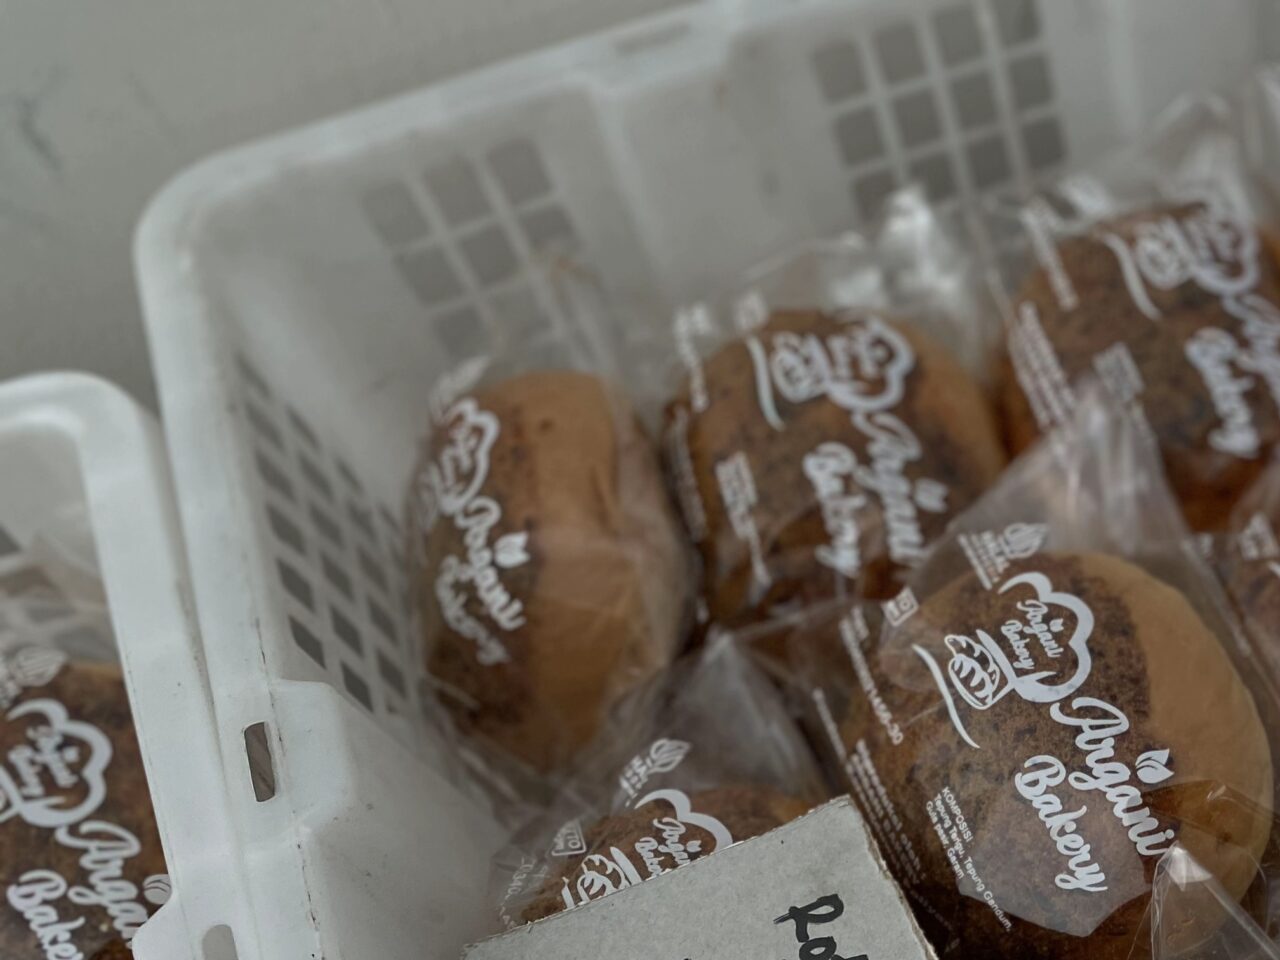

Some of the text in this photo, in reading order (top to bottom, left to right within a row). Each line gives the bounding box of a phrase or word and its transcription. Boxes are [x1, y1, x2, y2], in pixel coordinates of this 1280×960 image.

[1001, 620, 1036, 671] Bakery
[1017, 600, 1064, 659] Argani
[1050, 697, 1179, 856] Argani
[942, 786, 973, 842] KOMPOSISI
[1014, 755, 1109, 893] Bakery
[963, 856, 985, 892] Tepung
